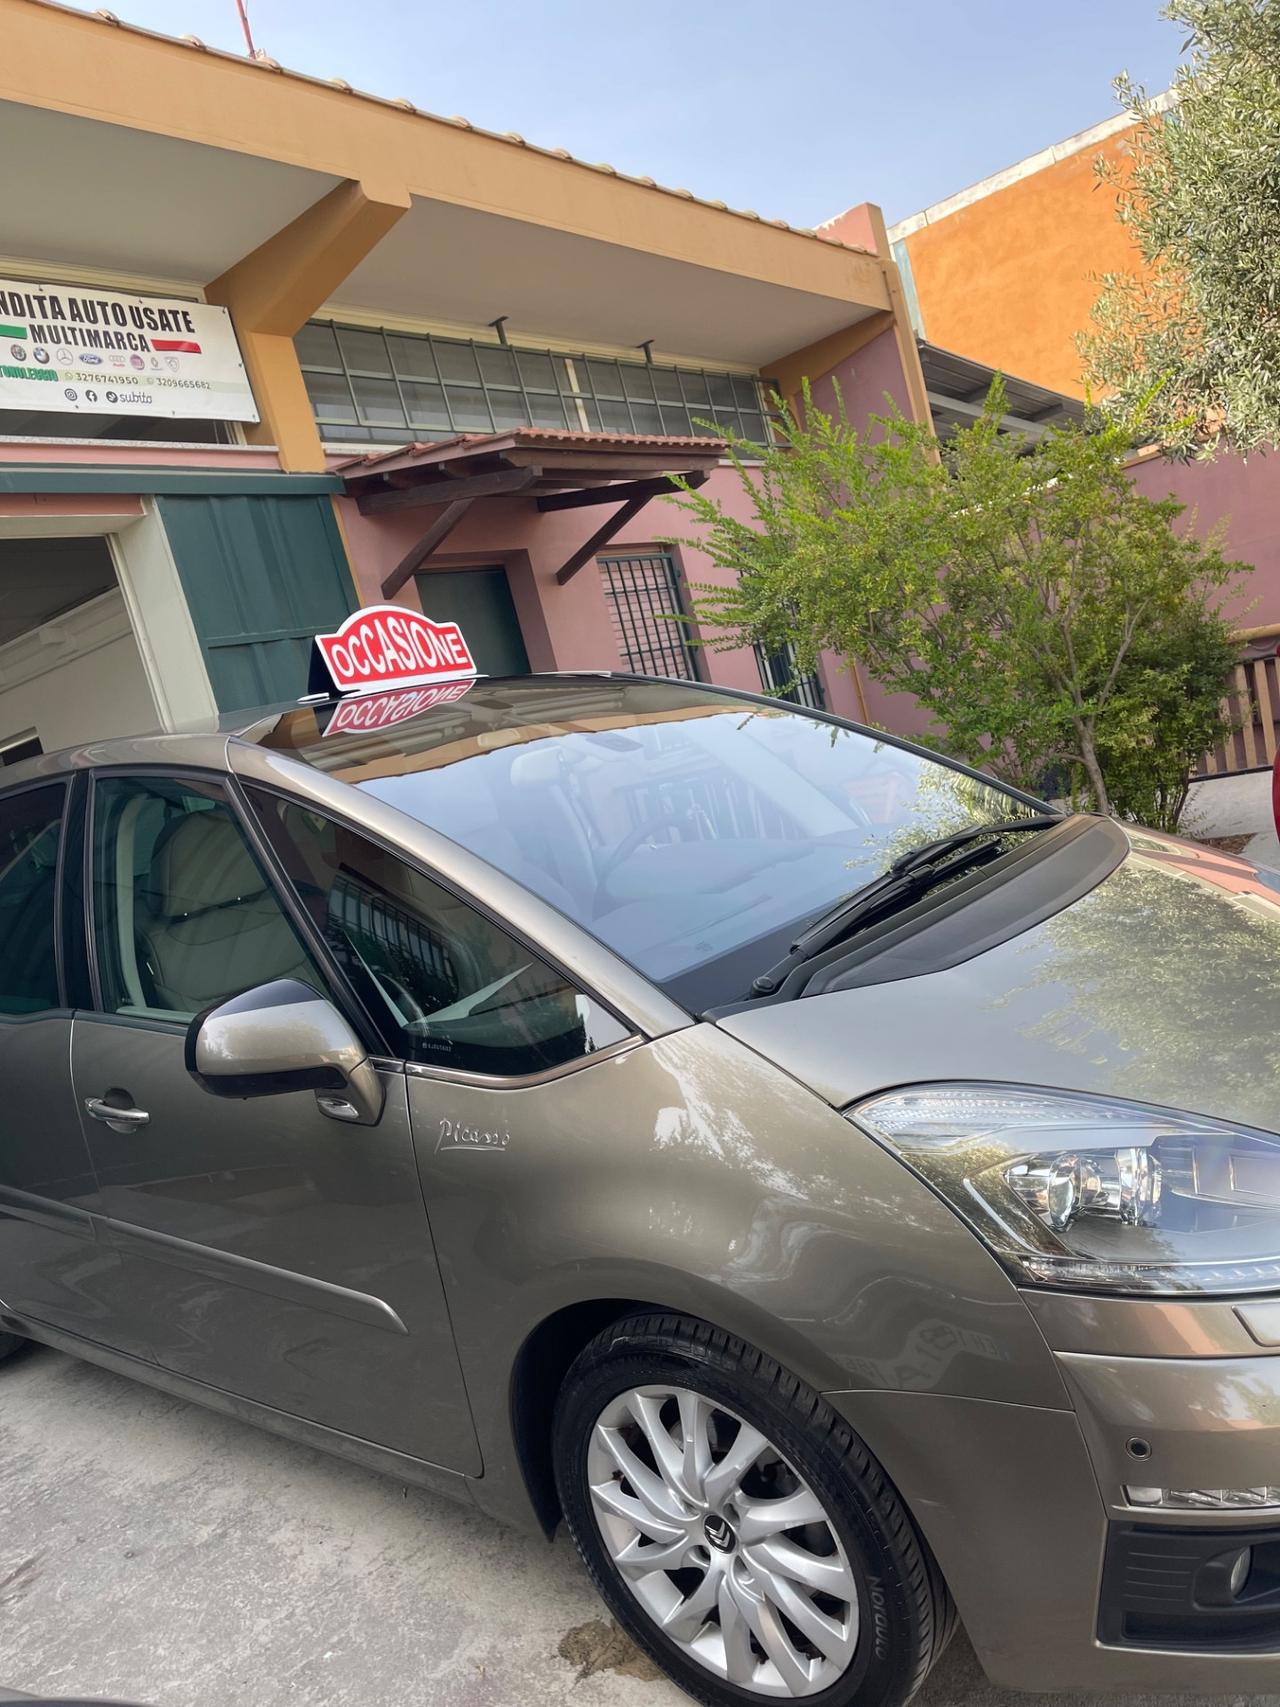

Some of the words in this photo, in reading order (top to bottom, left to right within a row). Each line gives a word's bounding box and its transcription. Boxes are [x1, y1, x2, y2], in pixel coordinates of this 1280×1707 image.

[68, 298, 128, 327] AUTO
[129, 305, 195, 333] USATE
[29, 324, 151, 352] MULTIMARCA
[75, 372, 139, 385] 3276741950
[156, 377, 211, 390] 3209665682
[119, 392, 153, 404] subito
[331, 616, 468, 677] OCCASIONE
[434, 1119, 510, 1154] Picasso
